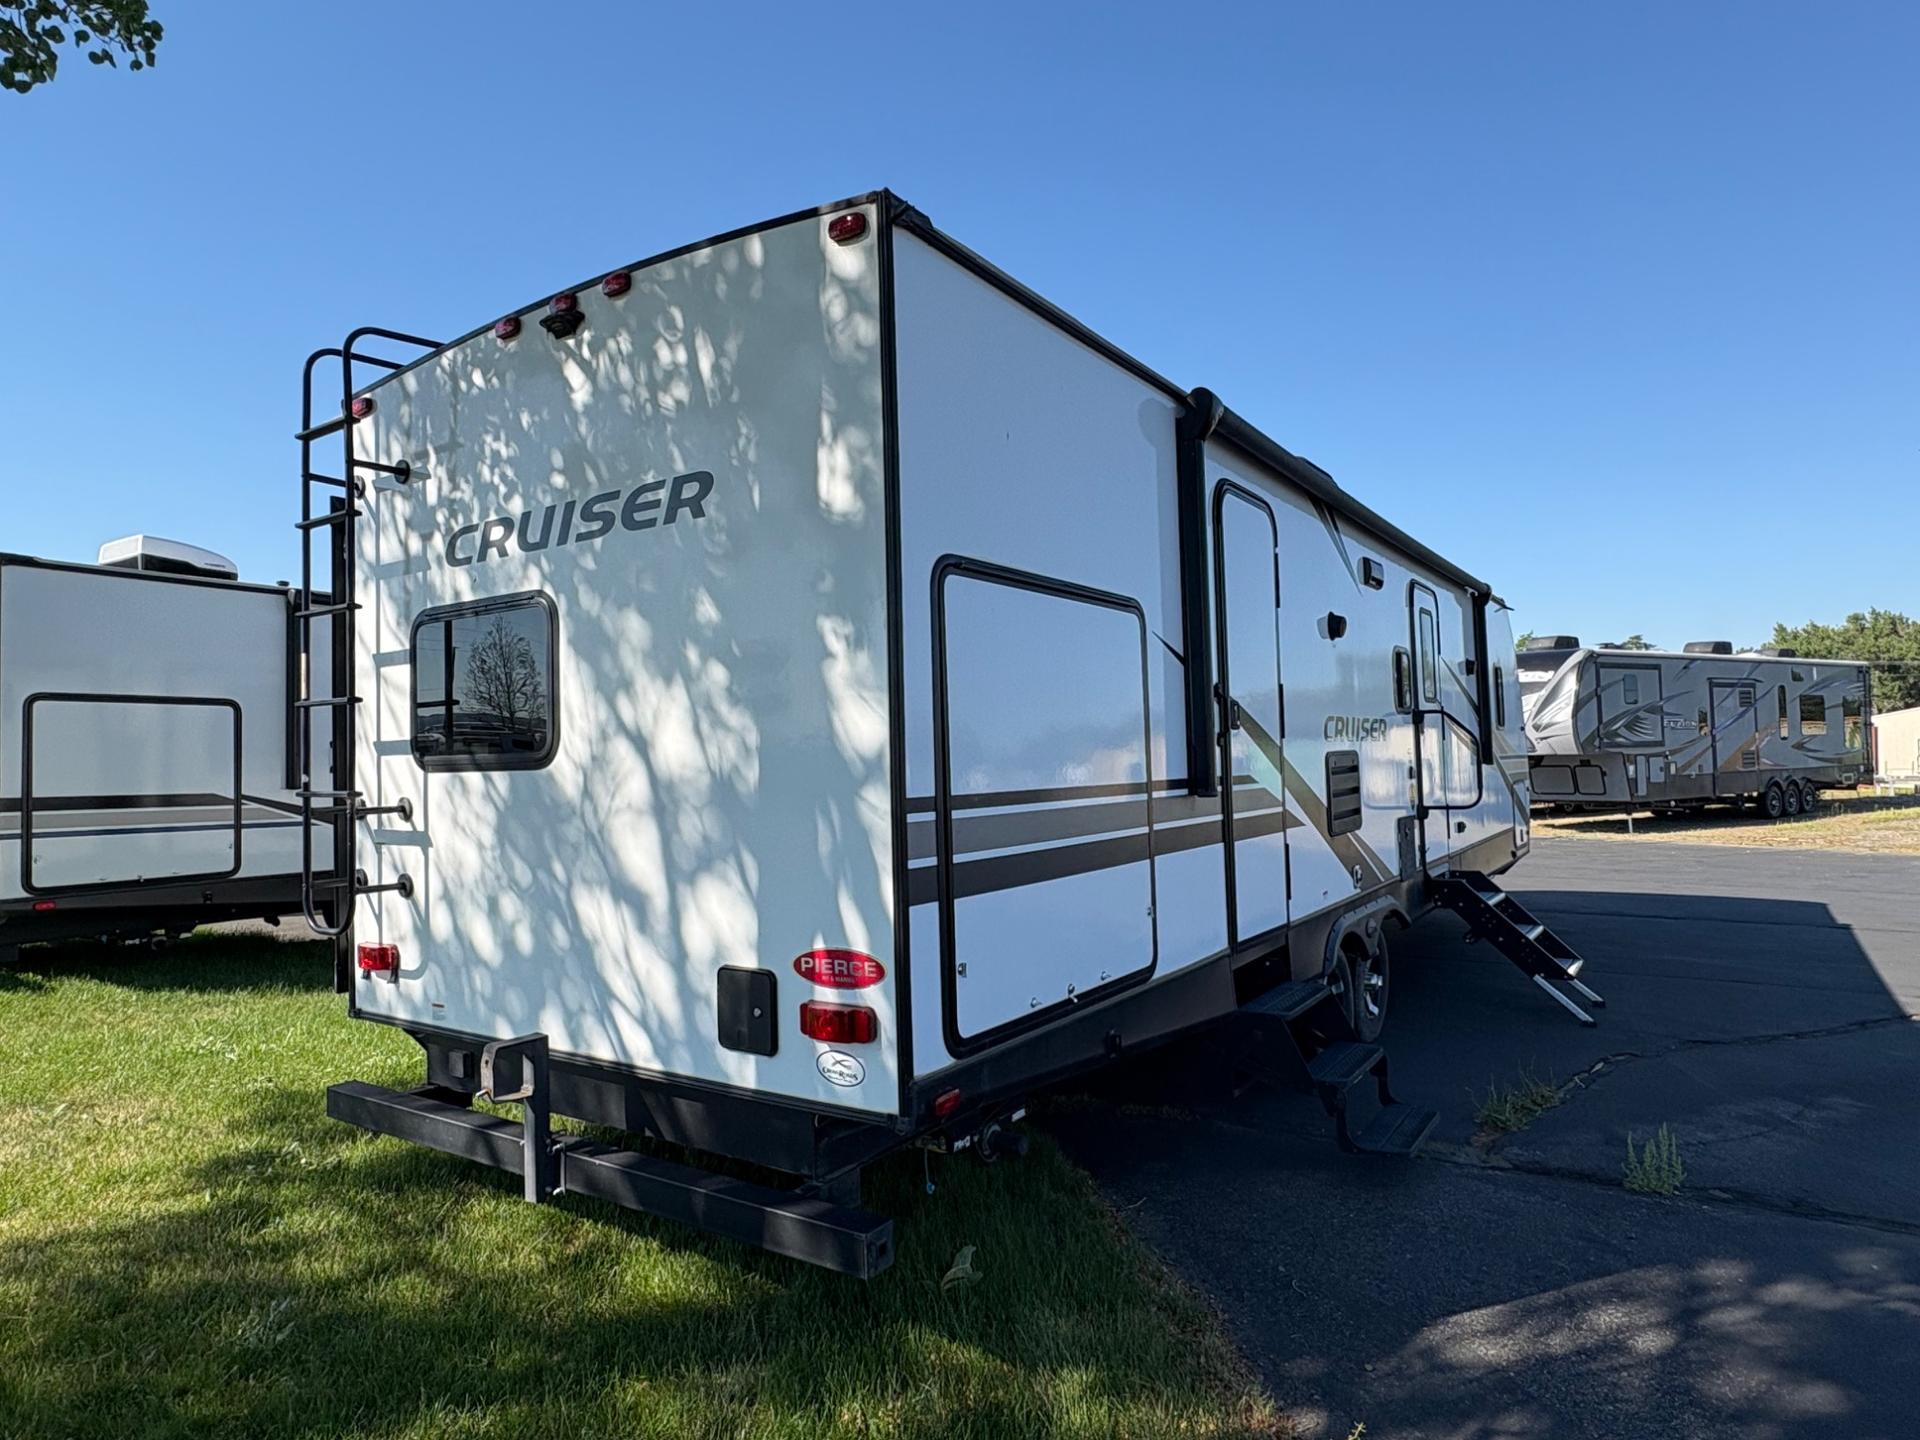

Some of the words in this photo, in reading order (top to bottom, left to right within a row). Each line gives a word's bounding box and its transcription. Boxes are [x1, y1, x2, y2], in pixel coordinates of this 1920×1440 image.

[445, 470, 715, 568] CRUISER
[1324, 715, 1387, 742] CRUISER
[800, 957, 877, 978] PIERCE
